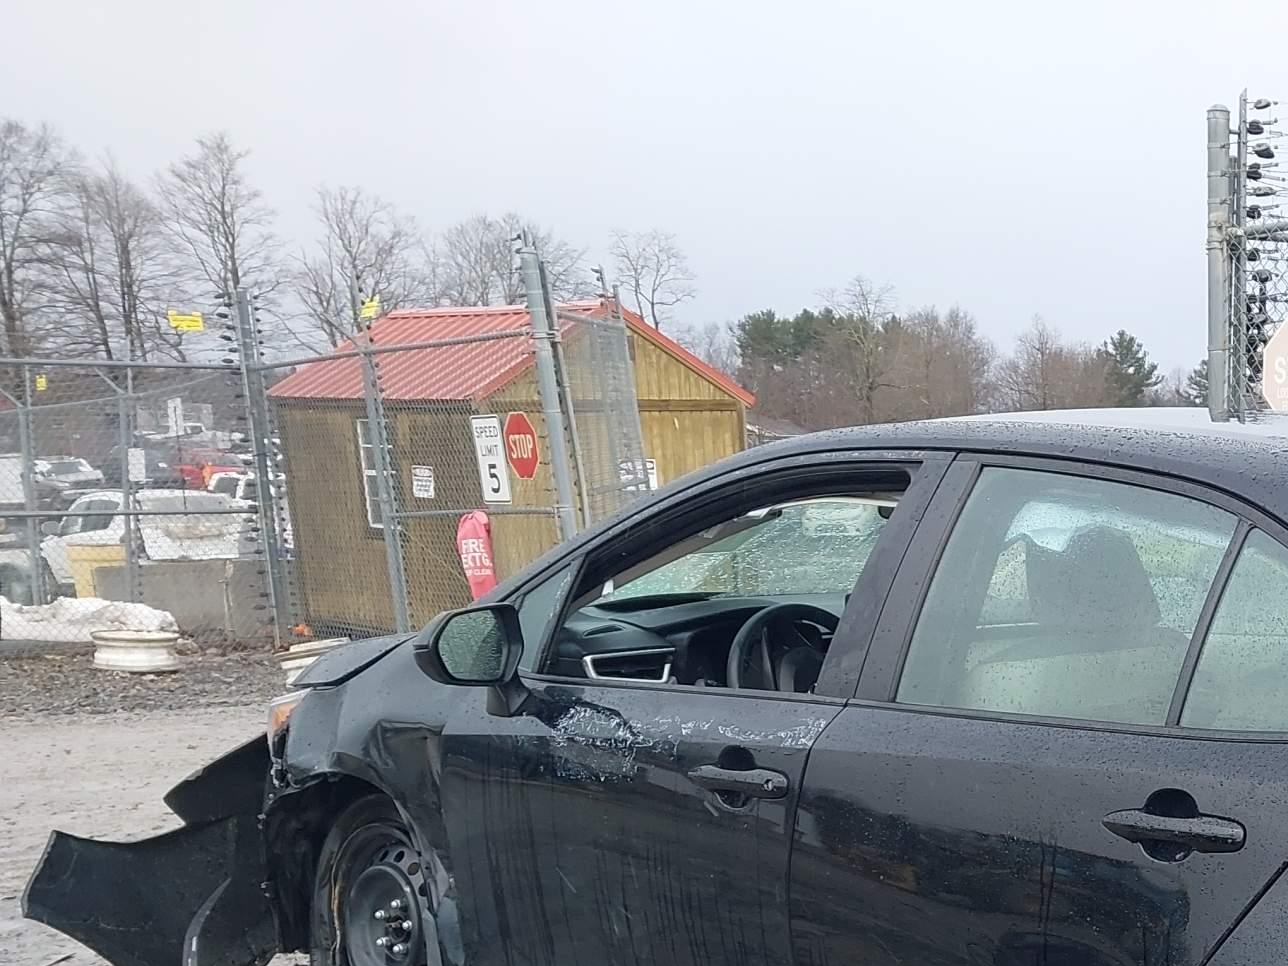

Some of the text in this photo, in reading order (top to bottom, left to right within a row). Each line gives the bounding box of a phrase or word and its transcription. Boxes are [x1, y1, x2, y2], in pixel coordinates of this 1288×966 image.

[474, 425, 499, 439] SPEED
[480, 443, 499, 457] LIMIT
[508, 433, 534, 459] STOP
[487, 463, 501, 494] 5
